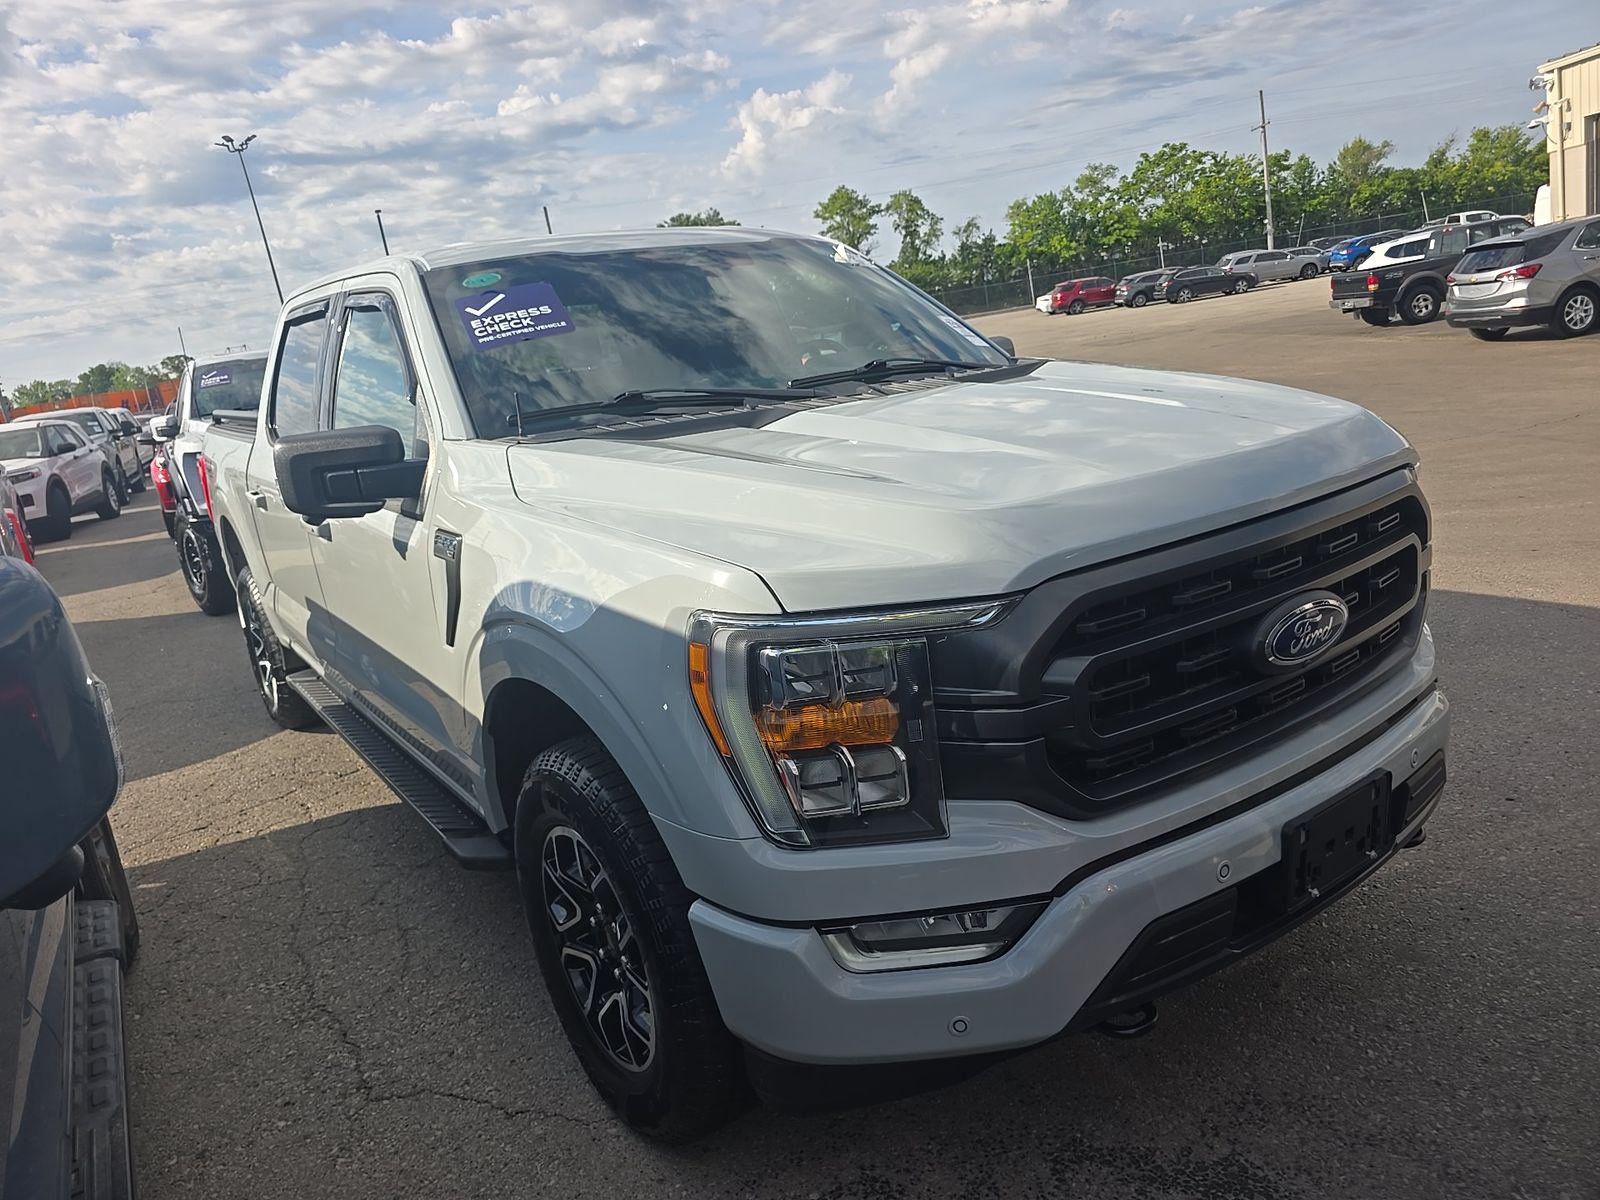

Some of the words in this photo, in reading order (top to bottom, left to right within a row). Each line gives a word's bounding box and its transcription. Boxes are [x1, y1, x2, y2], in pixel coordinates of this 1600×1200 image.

[470, 305, 552, 329] EXPRESS
[474, 317, 535, 337] CHECK
[478, 327, 535, 343] PRE-CERTIFIED
[534, 321, 567, 331] VEHICLE
[1290, 613, 1334, 655] Ford
